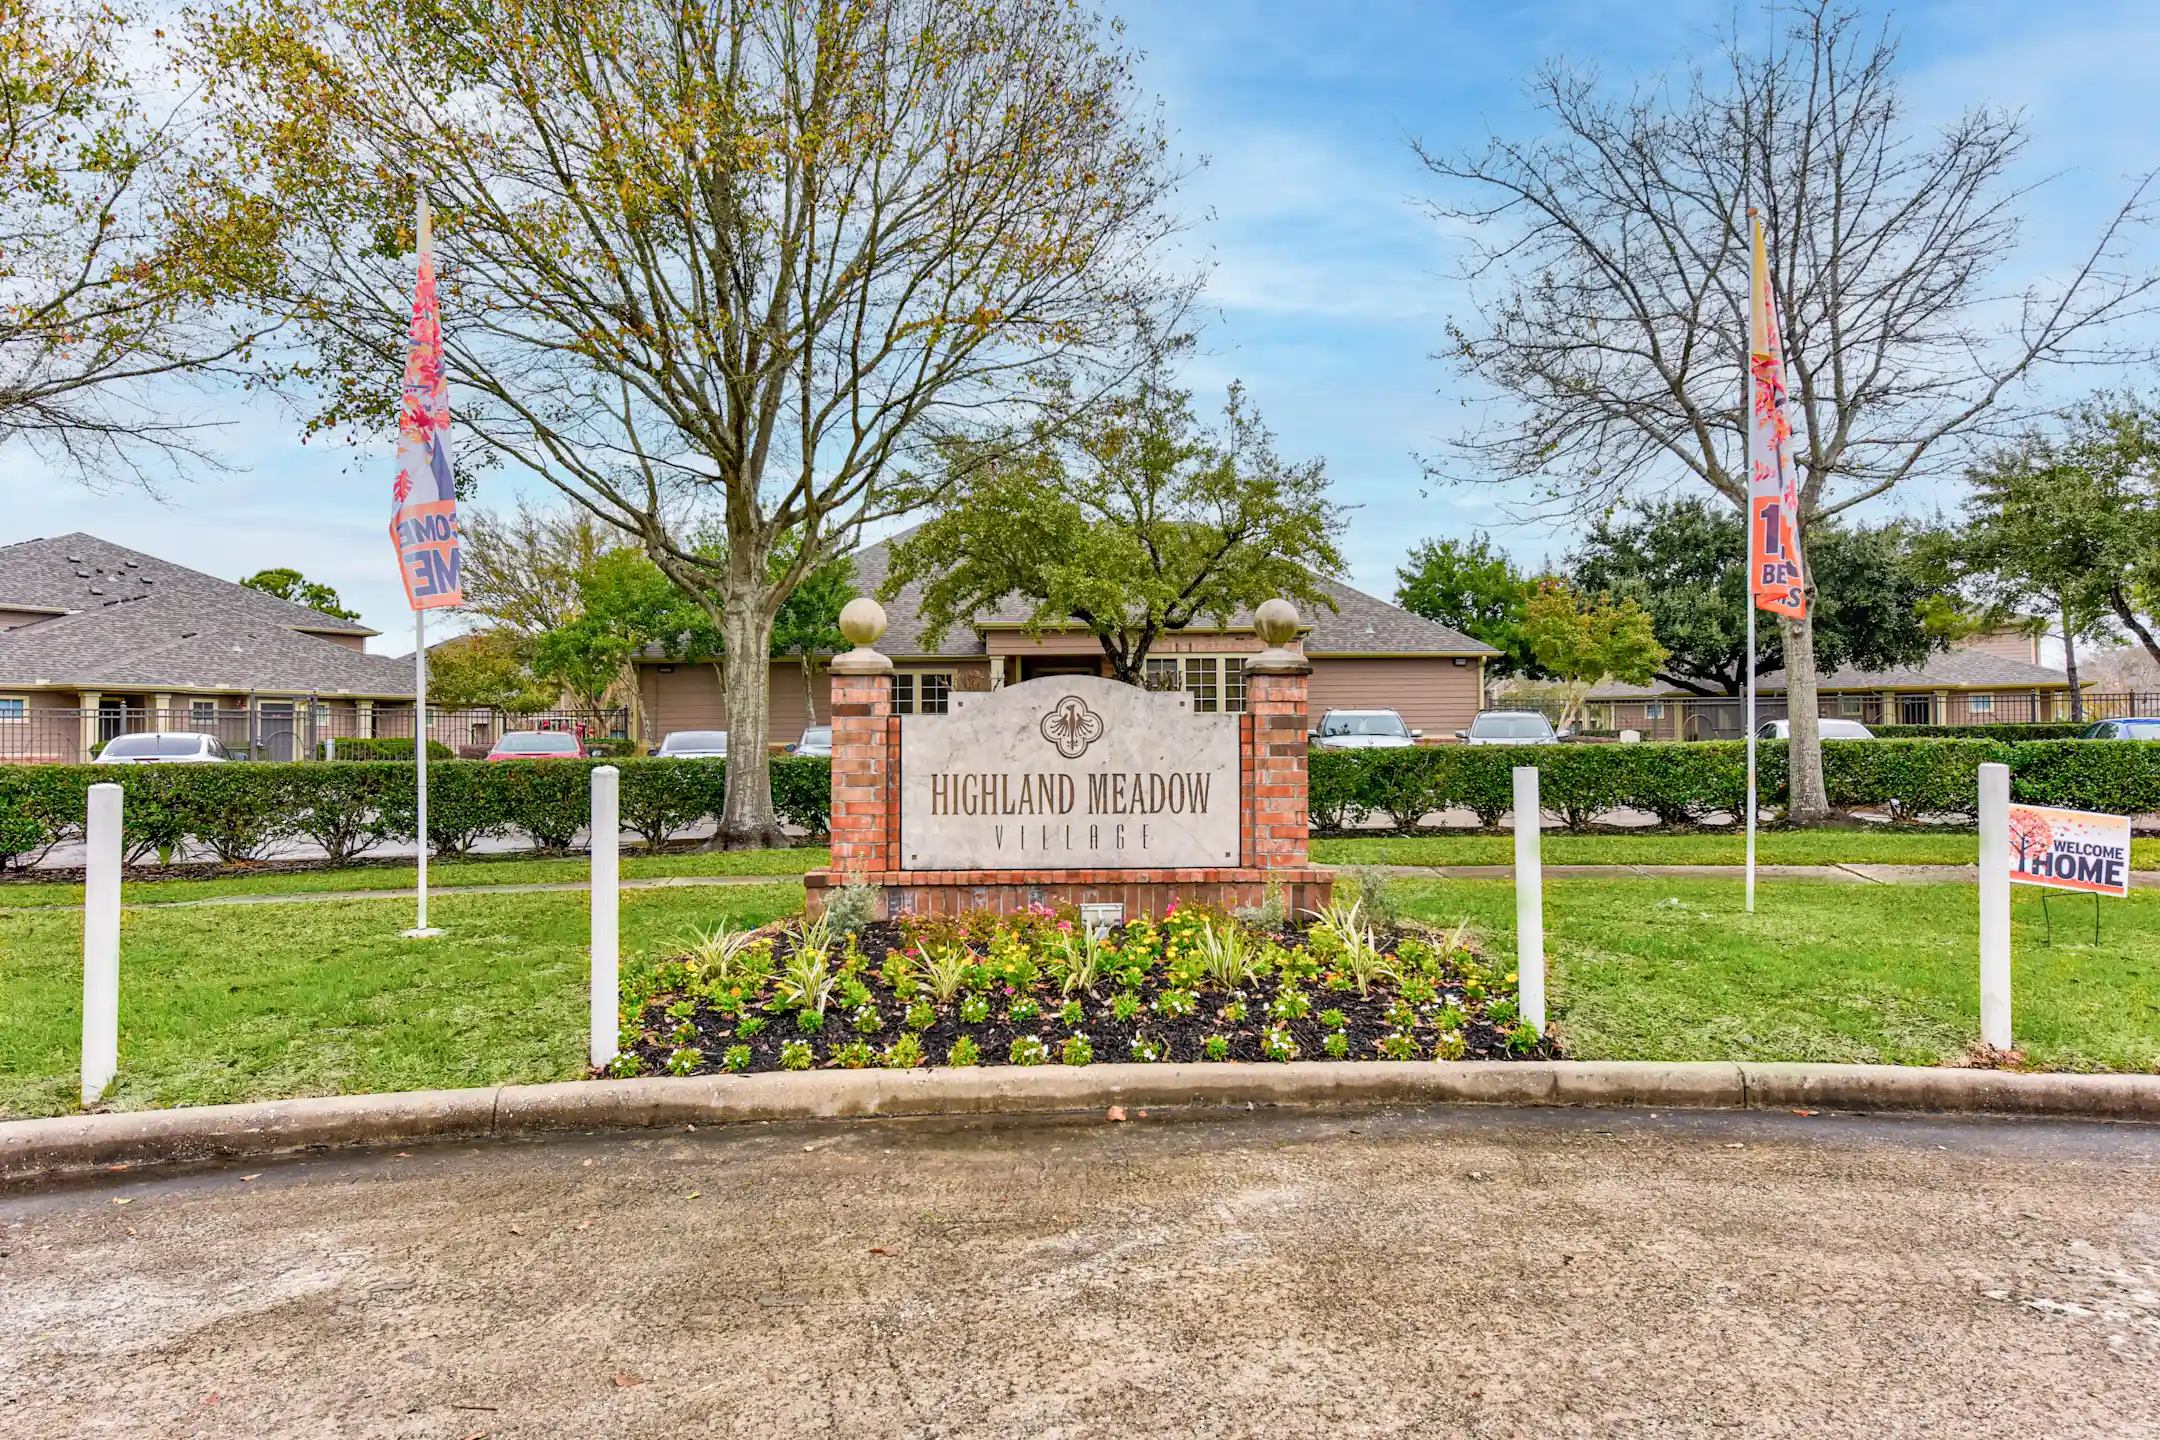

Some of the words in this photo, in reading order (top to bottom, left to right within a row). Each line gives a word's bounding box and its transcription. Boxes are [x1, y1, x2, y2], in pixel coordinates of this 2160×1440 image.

[931, 773, 1075, 815] HIGHLAND
[1088, 772, 1211, 814] MEADOW
[995, 823, 1149, 850] VILLAGE
[2053, 839, 2124, 860] WELCOME
[2031, 852, 2124, 887] HOME
